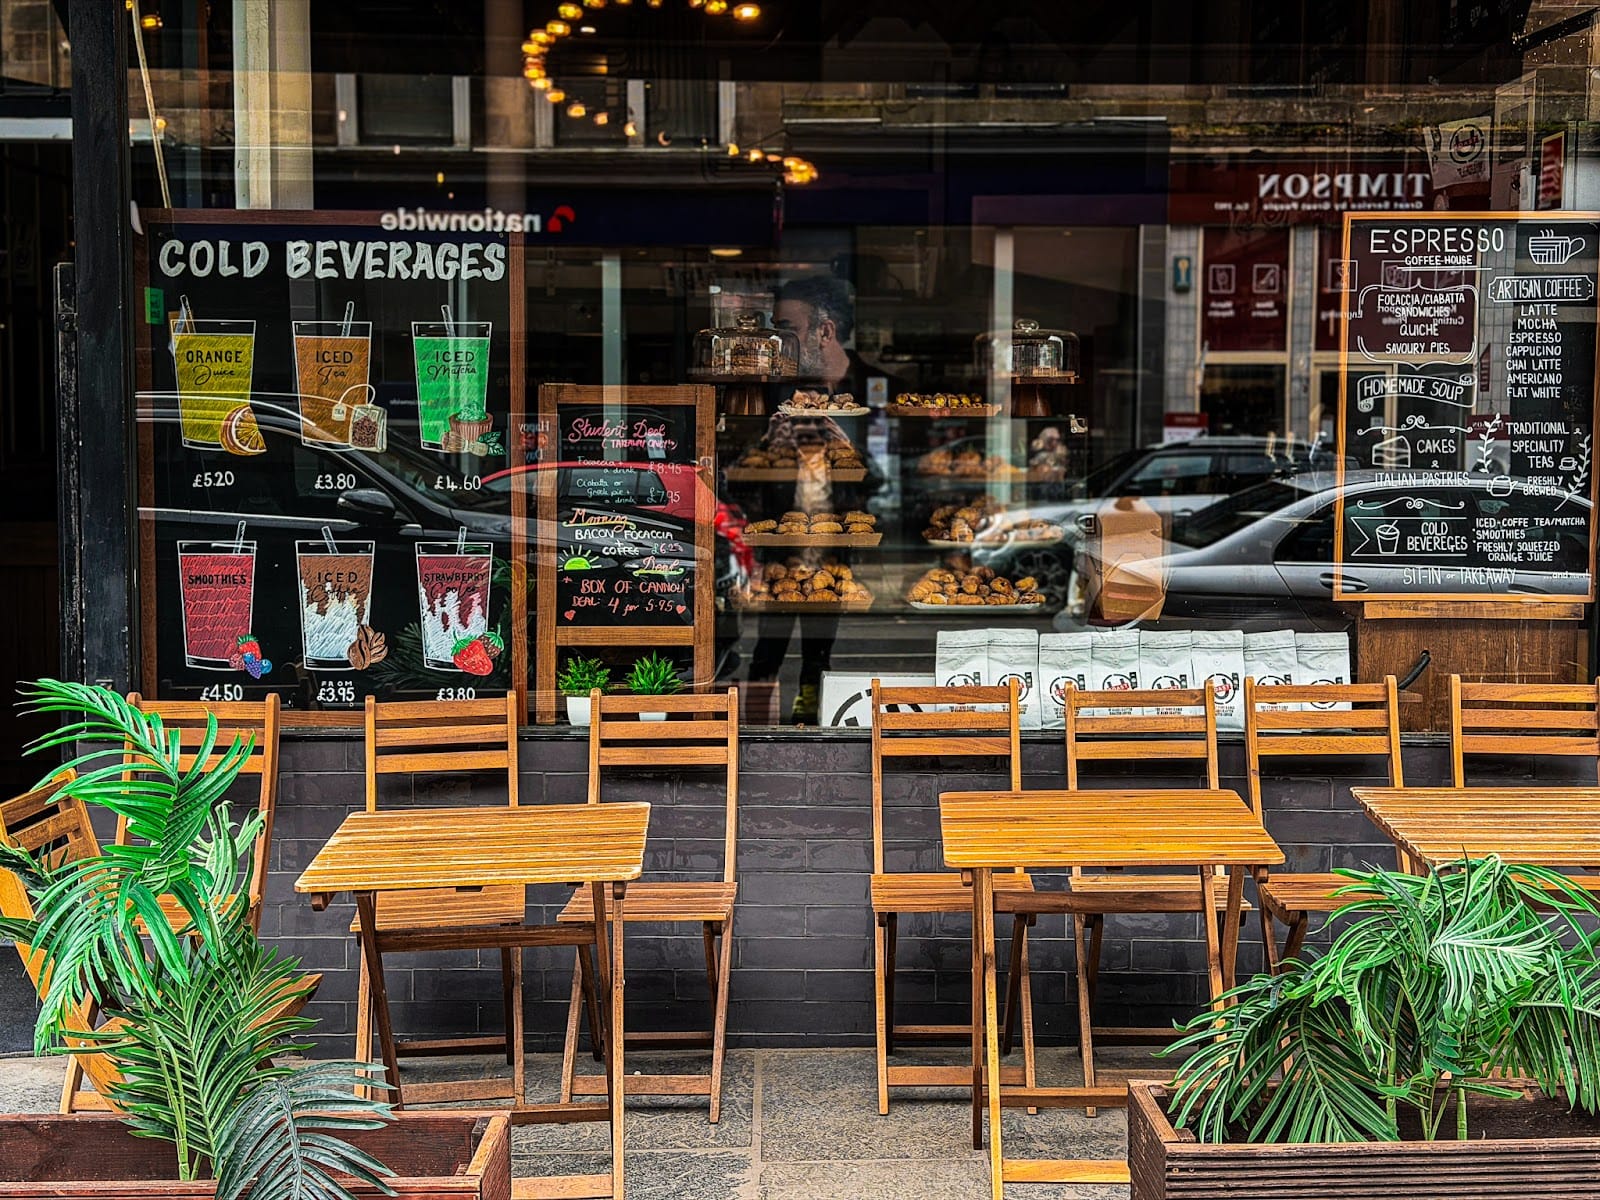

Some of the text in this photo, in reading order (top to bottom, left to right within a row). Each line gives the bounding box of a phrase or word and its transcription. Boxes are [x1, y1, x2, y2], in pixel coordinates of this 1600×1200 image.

[1370, 228, 1504, 253] ESPRESSO
[159, 239, 506, 281] COLD BEVERAGES
[1405, 255, 1473, 265] COFFEE HOUSE
[1497, 278, 1582, 299] ARTISAN COFFEE
[1378, 293, 1465, 306] FOCACCIA/CIABATTA
[1395, 306, 1449, 318] SANDWICHES
[1521, 305, 1557, 316] LATTE
[1400, 324, 1439, 337] QUICHE
[1517, 318, 1557, 330] MOCHA
[1509, 332, 1562, 344] ESPRESSO
[1385, 342, 1450, 355] SAVOURY PIES
[1506, 346, 1562, 357] CAPPUCINO
[186, 350, 242, 364] ORANGE
[315, 350, 353, 363] ICED
[435, 350, 475, 363] ICED
[427, 364, 478, 379] Matcha
[1506, 359, 1561, 371] CHAI LATTE
[193, 366, 235, 385] Juice
[318, 365, 347, 381] Tea
[1506, 373, 1562, 384] AMERICANO
[1364, 379, 1464, 401] HOMEMADE SOUP
[1506, 387, 1561, 398] FLAT WHITE
[568, 417, 666, 443] Student Deal
[1506, 422, 1570, 435] TRADITIONAL
[1416, 439, 1456, 453] CAKES
[1512, 440, 1565, 453] SPECIALITY
[648, 461, 682, 475] £8.95
[1528, 456, 1554, 468] TEAS
[612, 466, 637, 474] drink
[193, 471, 234, 488] £5.20
[314, 474, 356, 490] £3.80
[434, 475, 481, 491] £4.60
[1376, 472, 1470, 486] ITALIAN PASTRIES
[1527, 476, 1563, 486] FRESHLY
[646, 487, 681, 503] £7.95
[1523, 486, 1557, 496] BREWED
[614, 496, 637, 504] drink
[1421, 522, 1448, 536] COLD
[1476, 517, 1586, 528] ICED-COFFE TEA/MATCHA
[575, 529, 673, 540] BACON FOCACCIA
[1476, 529, 1526, 540] SMOOTHIES
[1407, 536, 1468, 552] BEVEREGES
[1476, 542, 1560, 552] FRESHLY SQUEEZED
[602, 546, 640, 556] COFFEE
[1488, 552, 1553, 563] ORANGE JUICE
[187, 573, 247, 586] SMOOTHIES
[317, 572, 358, 583] ICED
[424, 573, 486, 582] STRAWBERRY
[1403, 567, 1441, 585] SIT-IN
[1459, 567, 1516, 585] TAKEAWAY
[581, 579, 685, 594] BOX OF CANNOLI
[608, 597, 620, 614] 4
[622, 604, 639, 617] for
[200, 684, 243, 701] £4.50
[316, 687, 355, 702] £3.95
[436, 687, 476, 701] £3.80
